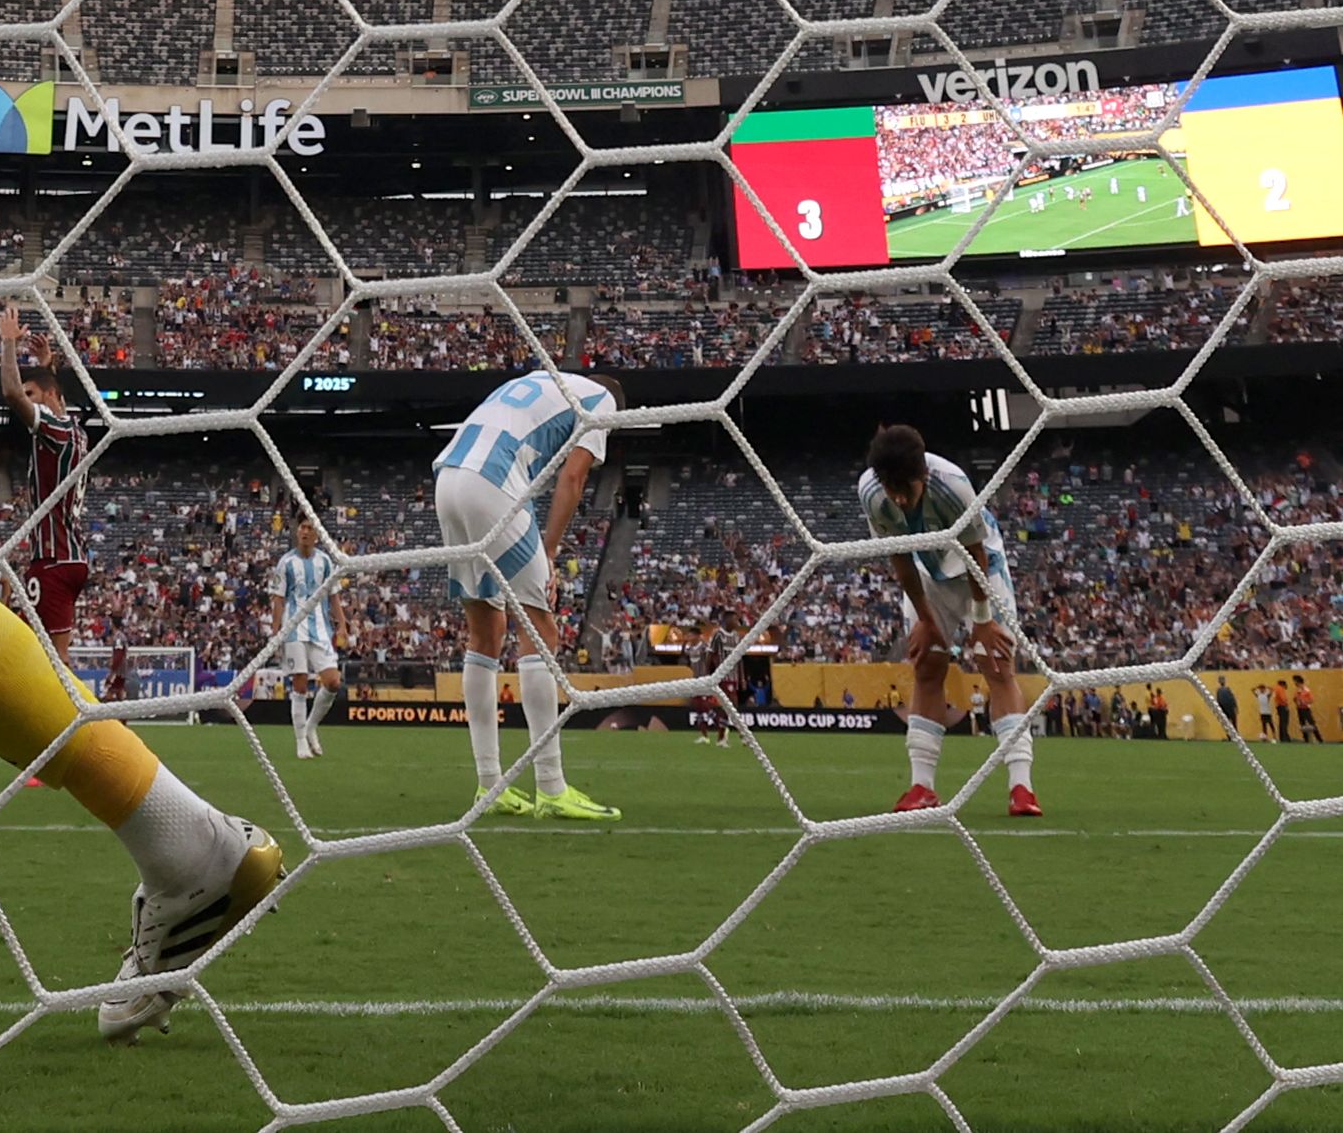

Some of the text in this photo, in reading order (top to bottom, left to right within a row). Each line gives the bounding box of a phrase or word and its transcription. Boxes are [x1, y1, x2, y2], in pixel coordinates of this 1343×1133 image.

[502, 88, 546, 102] SUPE
[591, 86, 601, 99] III
[603, 85, 682, 100] CHAMPIONS
[917, 58, 1100, 103] verizon
[64, 96, 326, 156] MetLife
[1261, 168, 1292, 212] 2
[797, 199, 824, 241] 3
[349, 707, 366, 721] FC
[368, 707, 415, 721] PORTO
[416, 708, 428, 722] V
[429, 709, 446, 722] AL
[756, 713, 806, 727] WORLD
[807, 714, 836, 728] CUP
